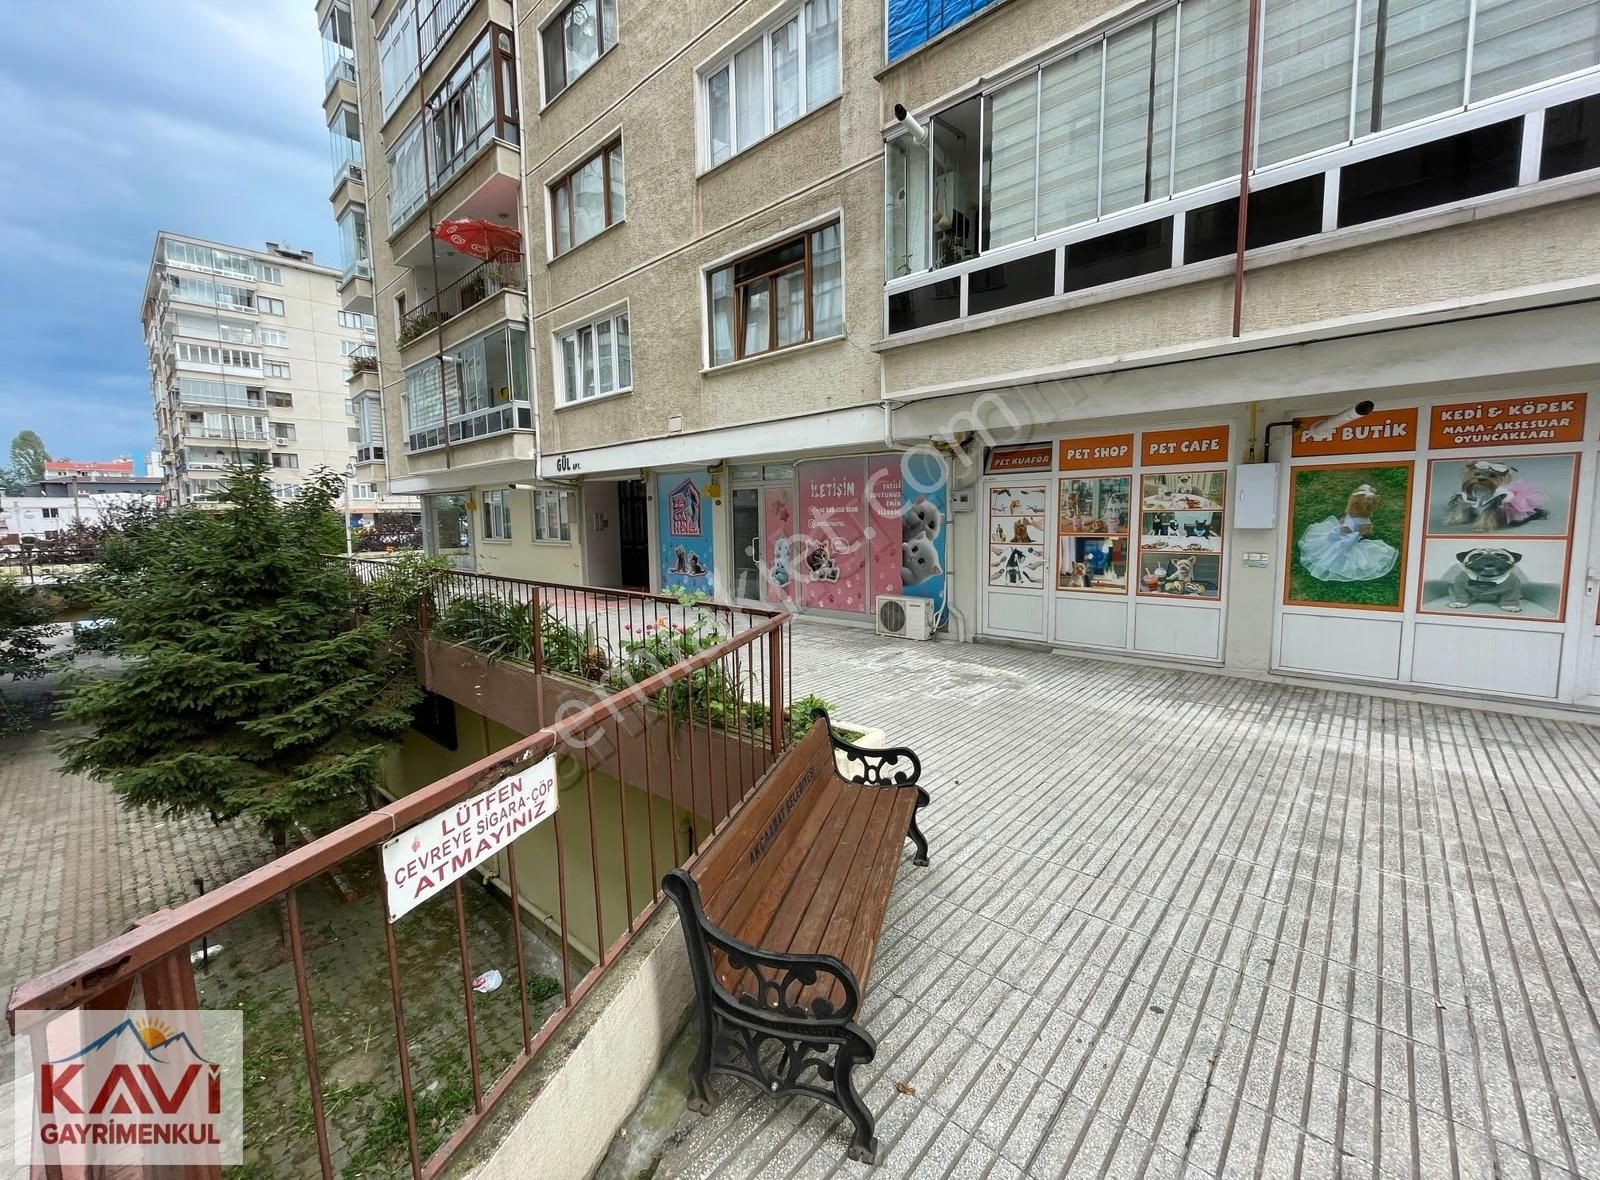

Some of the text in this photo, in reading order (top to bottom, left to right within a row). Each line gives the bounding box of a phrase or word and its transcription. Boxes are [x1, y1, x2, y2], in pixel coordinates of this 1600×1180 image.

[1441, 400, 1576, 421] KEDİ & KÖPEK
[1342, 419, 1408, 441] BUTİK
[1454, 429, 1556, 444] OYUNCAKLARI
[1066, 445, 1128, 460] PET SHOP
[1149, 438, 1220, 455] PET CAFE
[556, 455, 571, 472] GÜL
[810, 476, 856, 498] İLETİŞİM
[441, 777, 524, 837] LÜTFEN
[394, 777, 554, 888] ÇEVREYE SİGARA-ÇÖP
[414, 800, 547, 899] ATMAYINIZ
